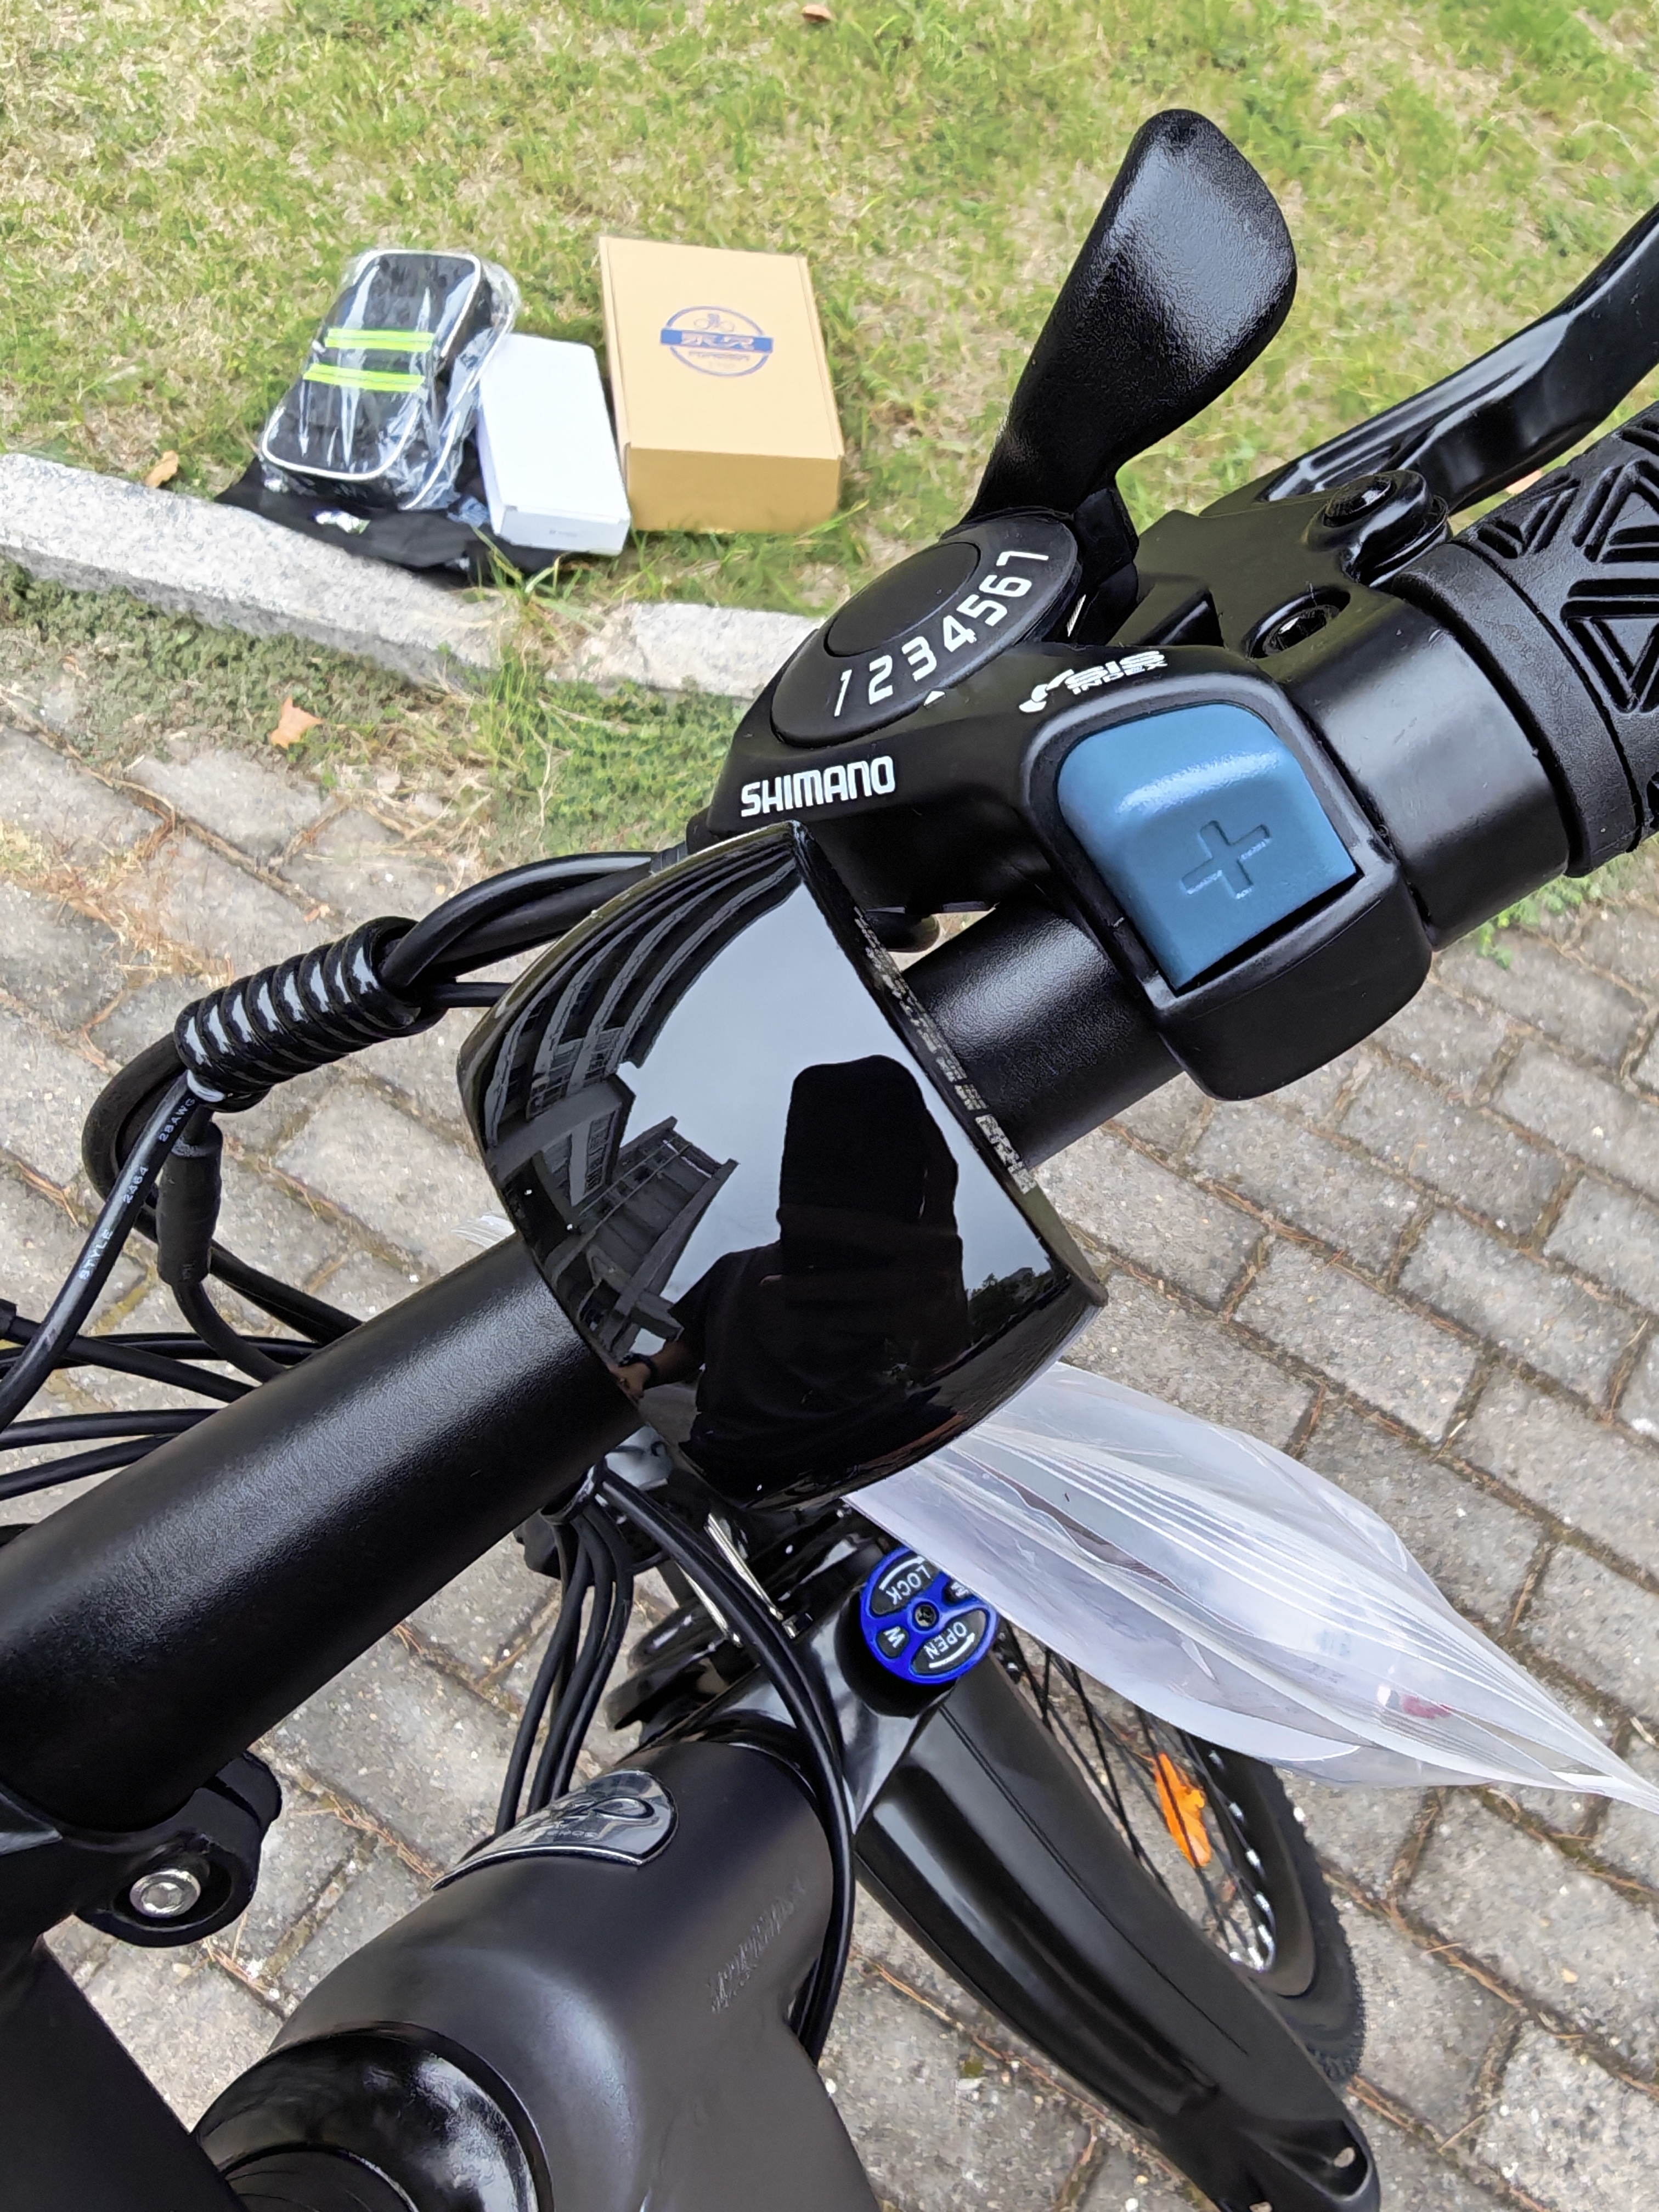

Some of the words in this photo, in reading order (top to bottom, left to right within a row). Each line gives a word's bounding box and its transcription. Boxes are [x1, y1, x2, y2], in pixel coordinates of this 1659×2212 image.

[741, 755, 895, 817] SHIMANO
[78, 1228, 113, 1280] STYLE
[885, 1566, 931, 1605] LOCK
[923, 1621, 967, 1660] OPEN
